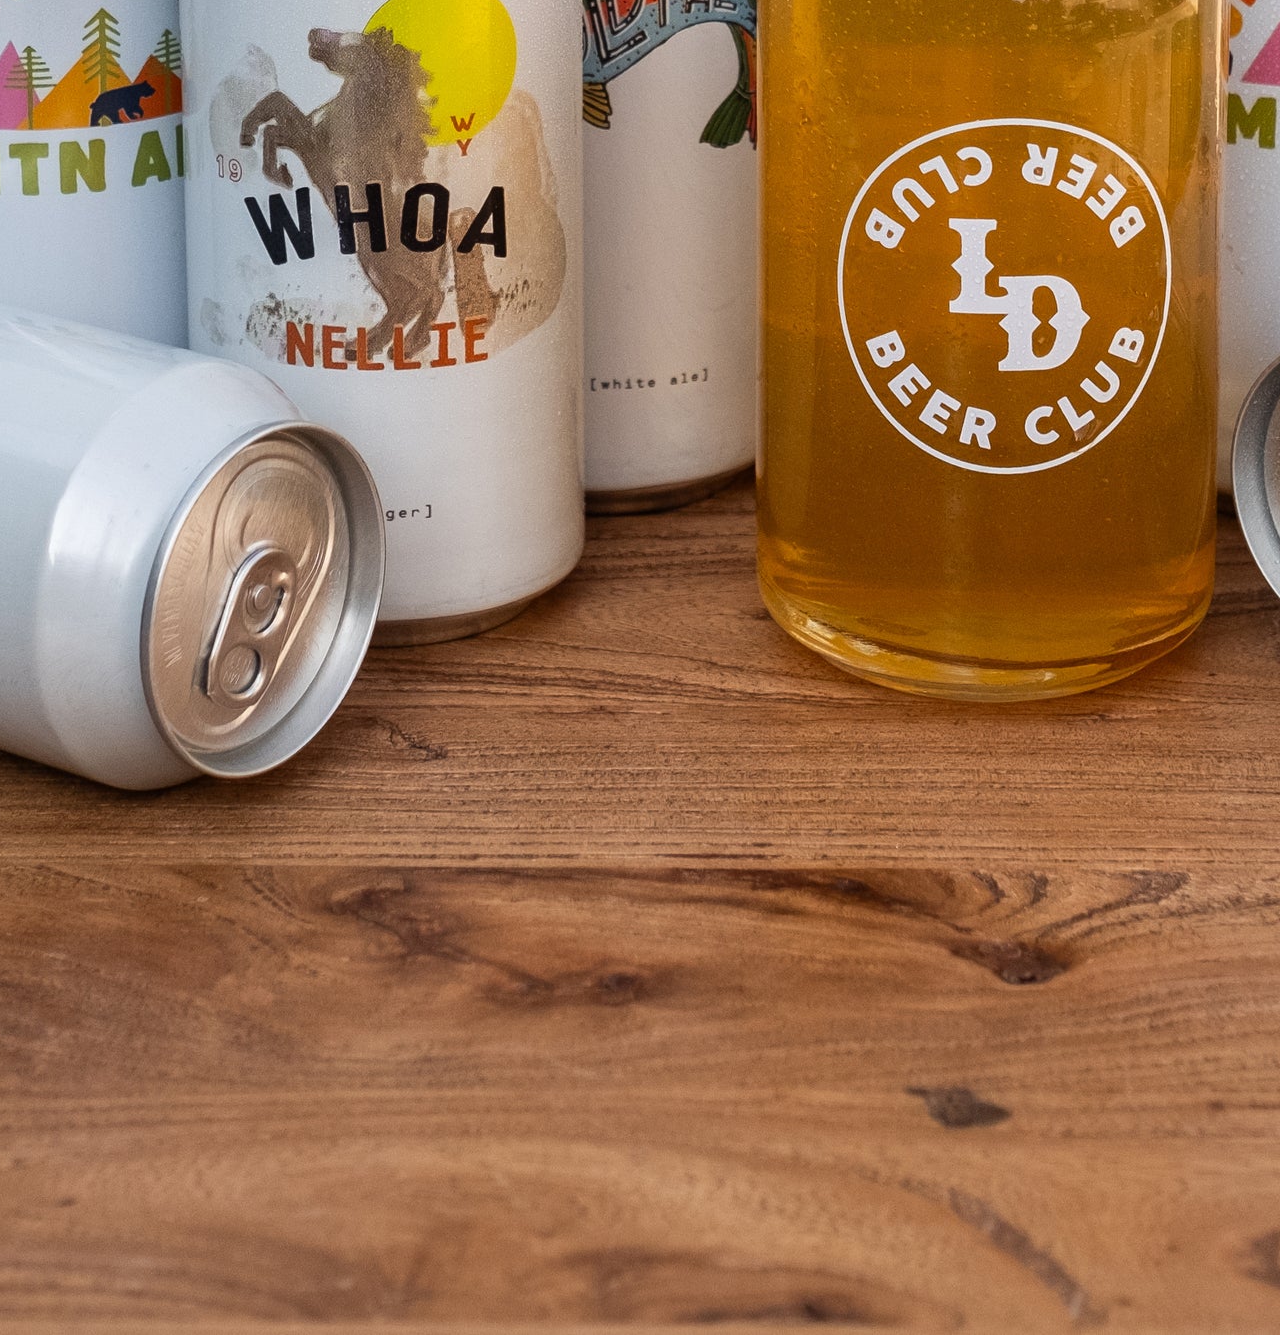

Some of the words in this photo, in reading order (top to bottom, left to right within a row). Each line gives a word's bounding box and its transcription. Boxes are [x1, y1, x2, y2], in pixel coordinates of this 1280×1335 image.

[216, 153, 243, 182] 19
[865, 146, 993, 250] CLUB
[1021, 143, 1147, 249] BEER
[244, 182, 508, 266] WHOA
[286, 318, 489, 371] NELLIE
[948, 218, 1091, 372] LD
[865, 330, 997, 450] BEER
[1024, 327, 1145, 445] CLUB
